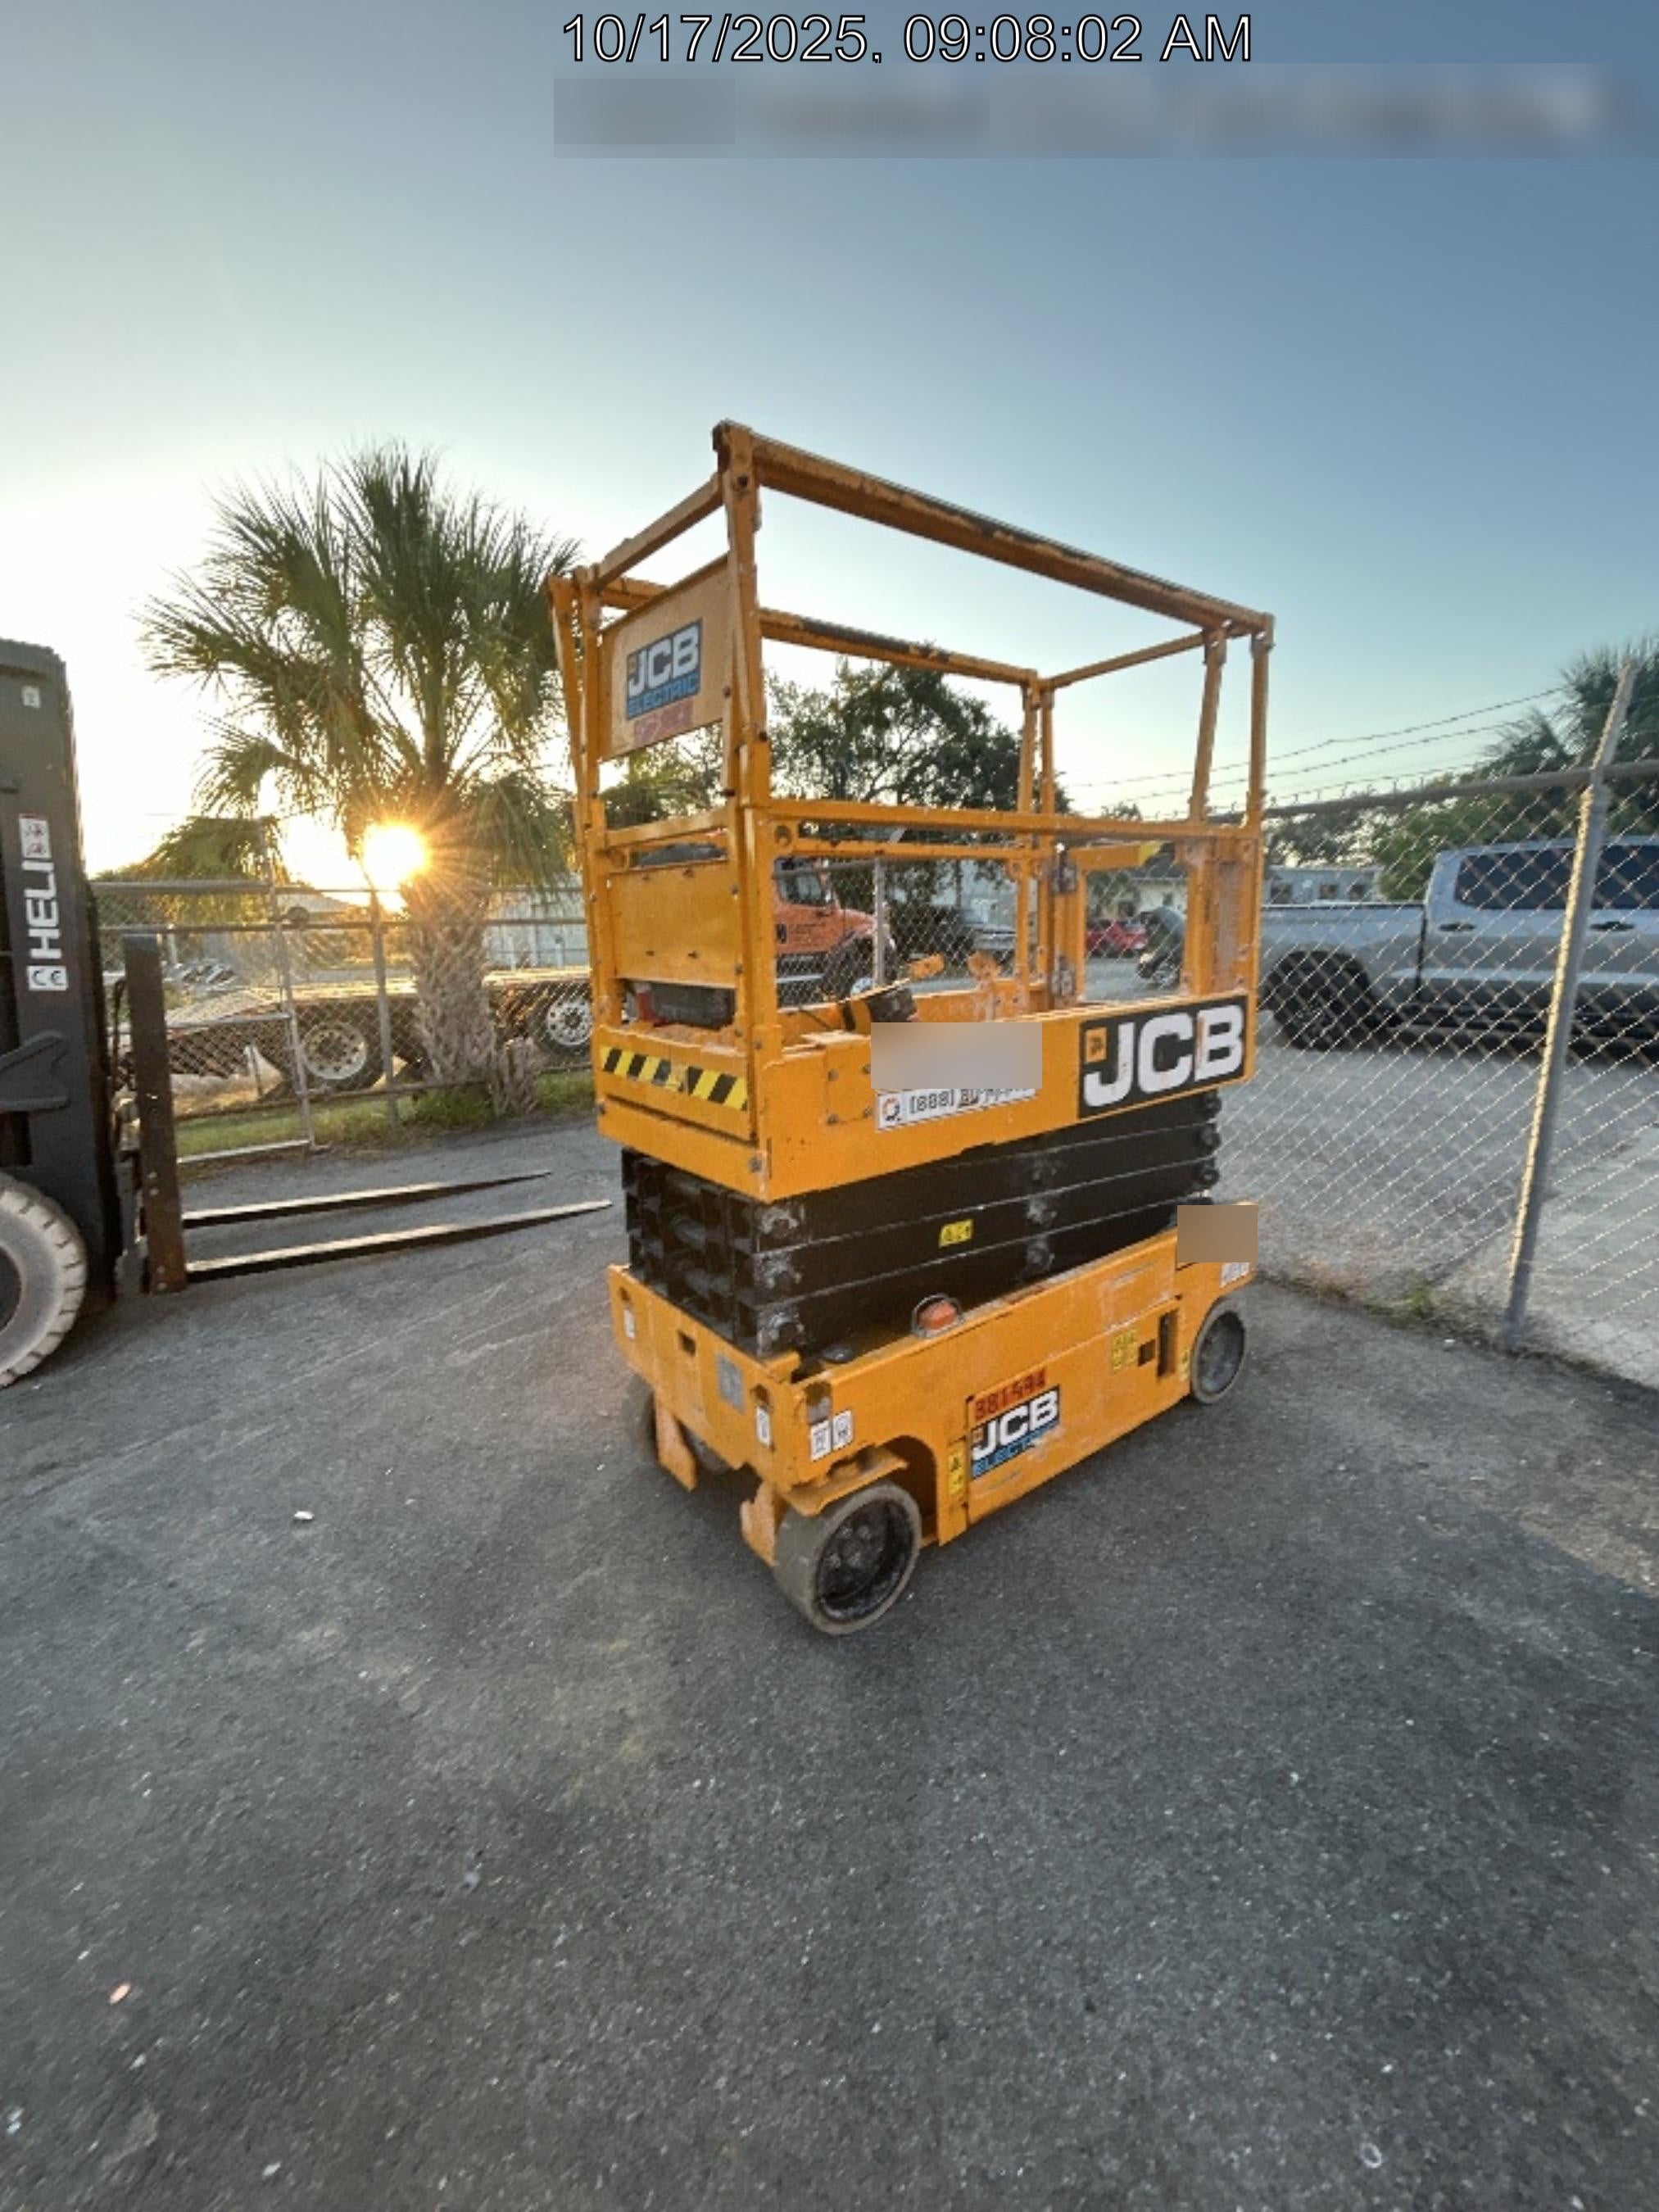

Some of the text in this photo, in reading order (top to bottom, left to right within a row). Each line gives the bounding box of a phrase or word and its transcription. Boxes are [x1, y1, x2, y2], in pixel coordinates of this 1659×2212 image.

[628, 624, 699, 696] JCB
[22, 861, 62, 959] HELI
[1083, 1004, 1244, 1107] JCB
[972, 1389, 1058, 1460] JCB
